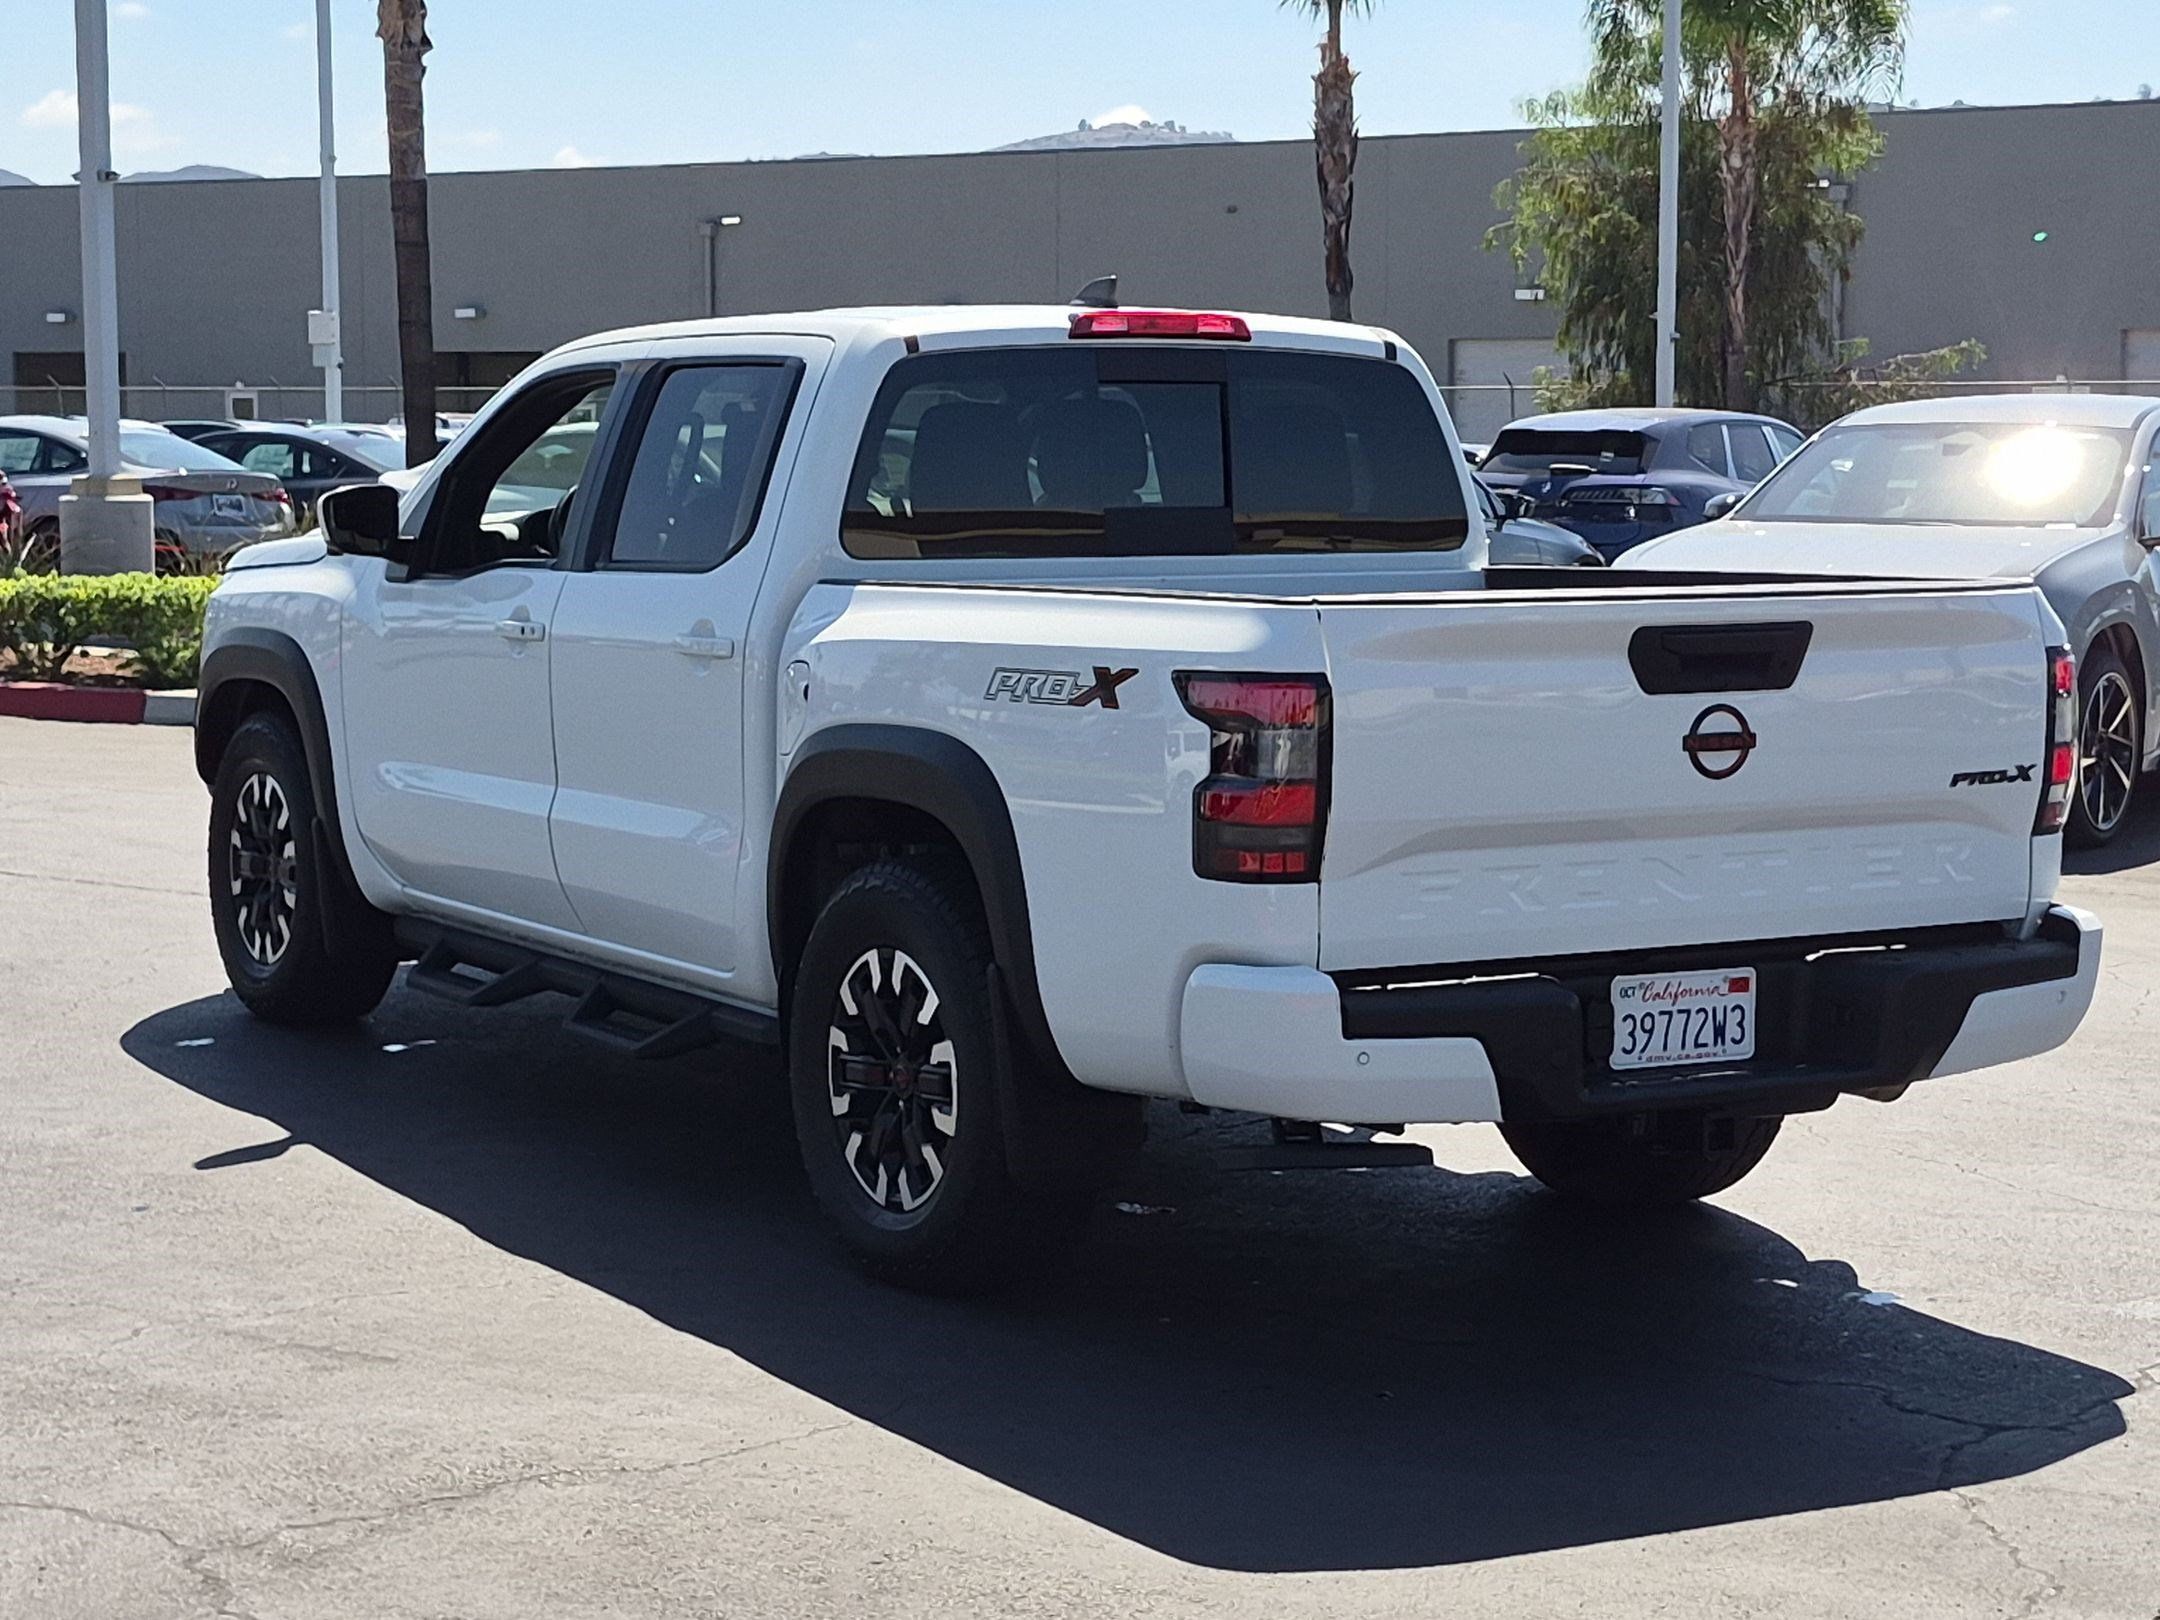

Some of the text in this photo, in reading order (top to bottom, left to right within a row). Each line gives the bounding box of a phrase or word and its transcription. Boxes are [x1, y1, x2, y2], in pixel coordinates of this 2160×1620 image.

[1398, 838, 1976, 921] FRONTIER
[1619, 987, 1637, 999] OCT
[1641, 980, 1729, 1007] California
[1621, 1004, 1746, 1055] 39772W3
